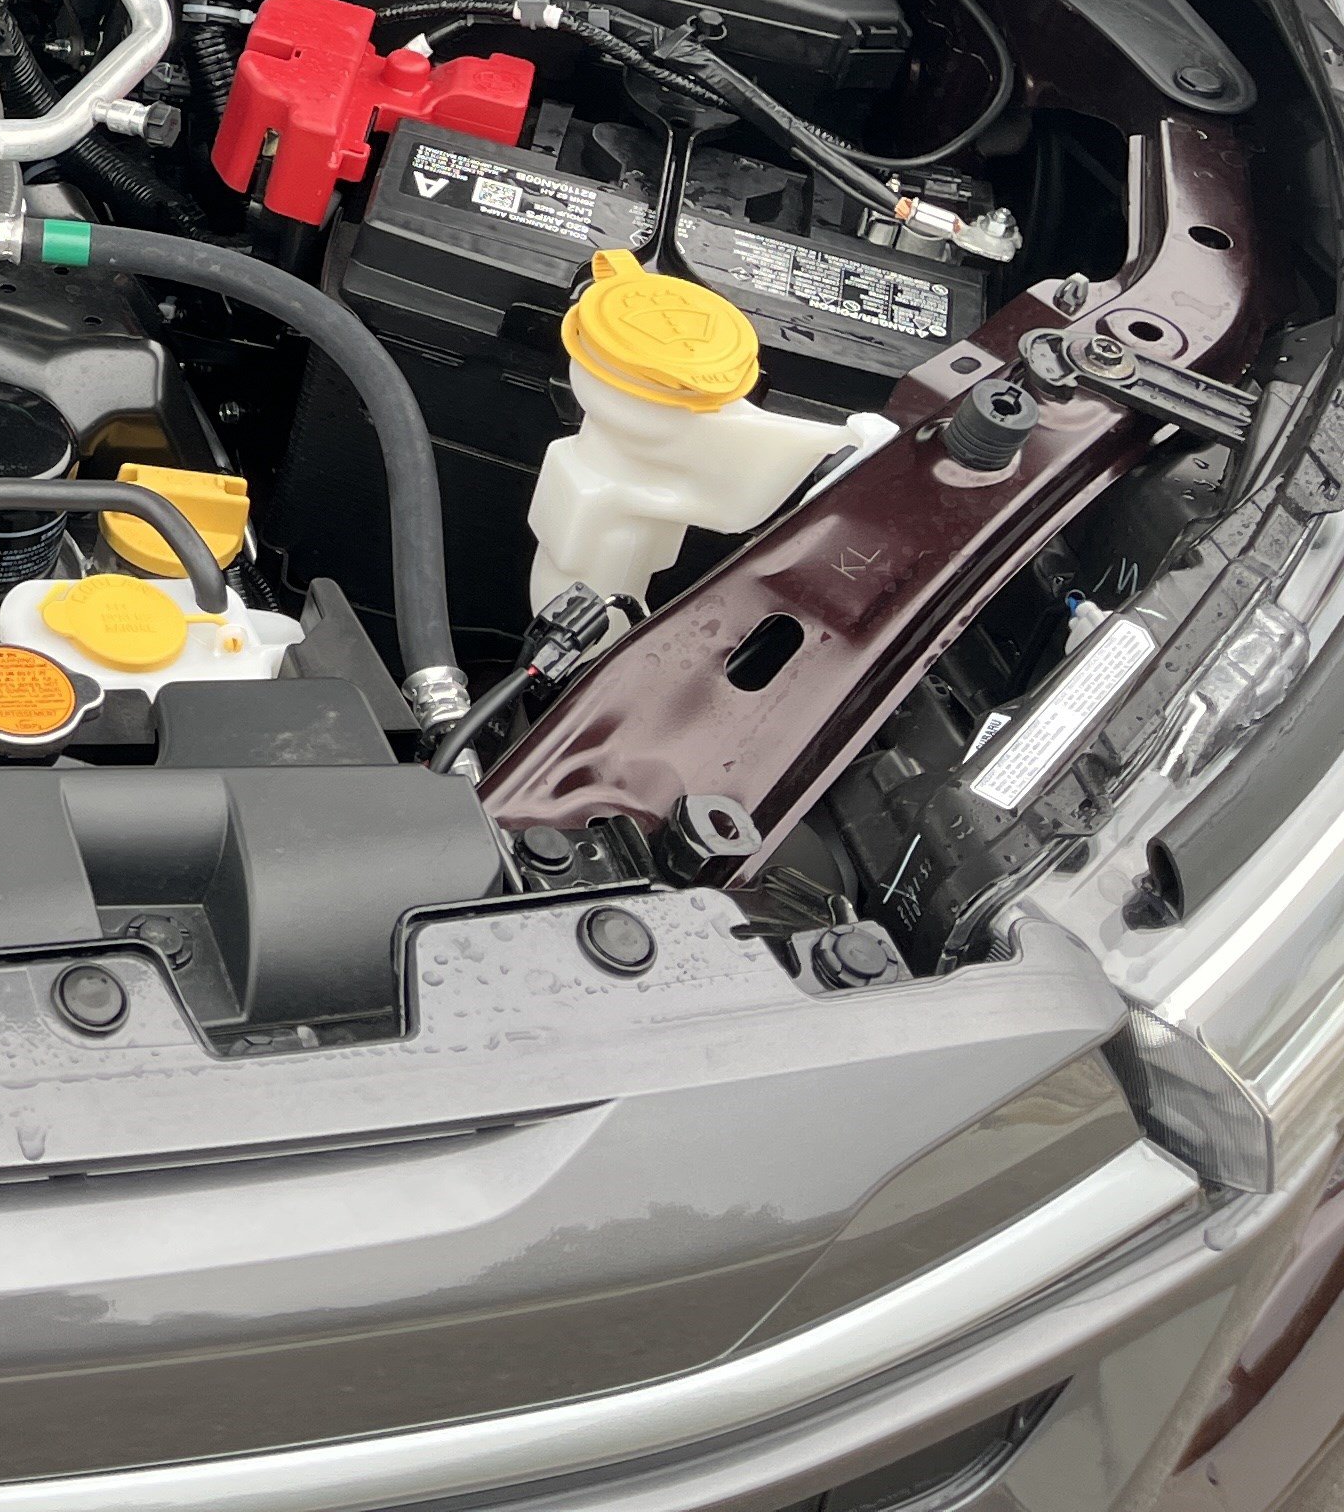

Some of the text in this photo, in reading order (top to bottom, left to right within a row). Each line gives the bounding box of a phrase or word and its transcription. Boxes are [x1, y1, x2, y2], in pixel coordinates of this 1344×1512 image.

[540, 187, 555, 197] AH
[525, 209, 565, 227] AMPS
[533, 203, 592, 225] GROUP SIZE
[567, 203, 593, 217] LN2
[479, 205, 588, 241] COLD CRANKING AMPS
[809, 298, 915, 336] DANGER/POISON
[830, 546, 881, 581] KL
